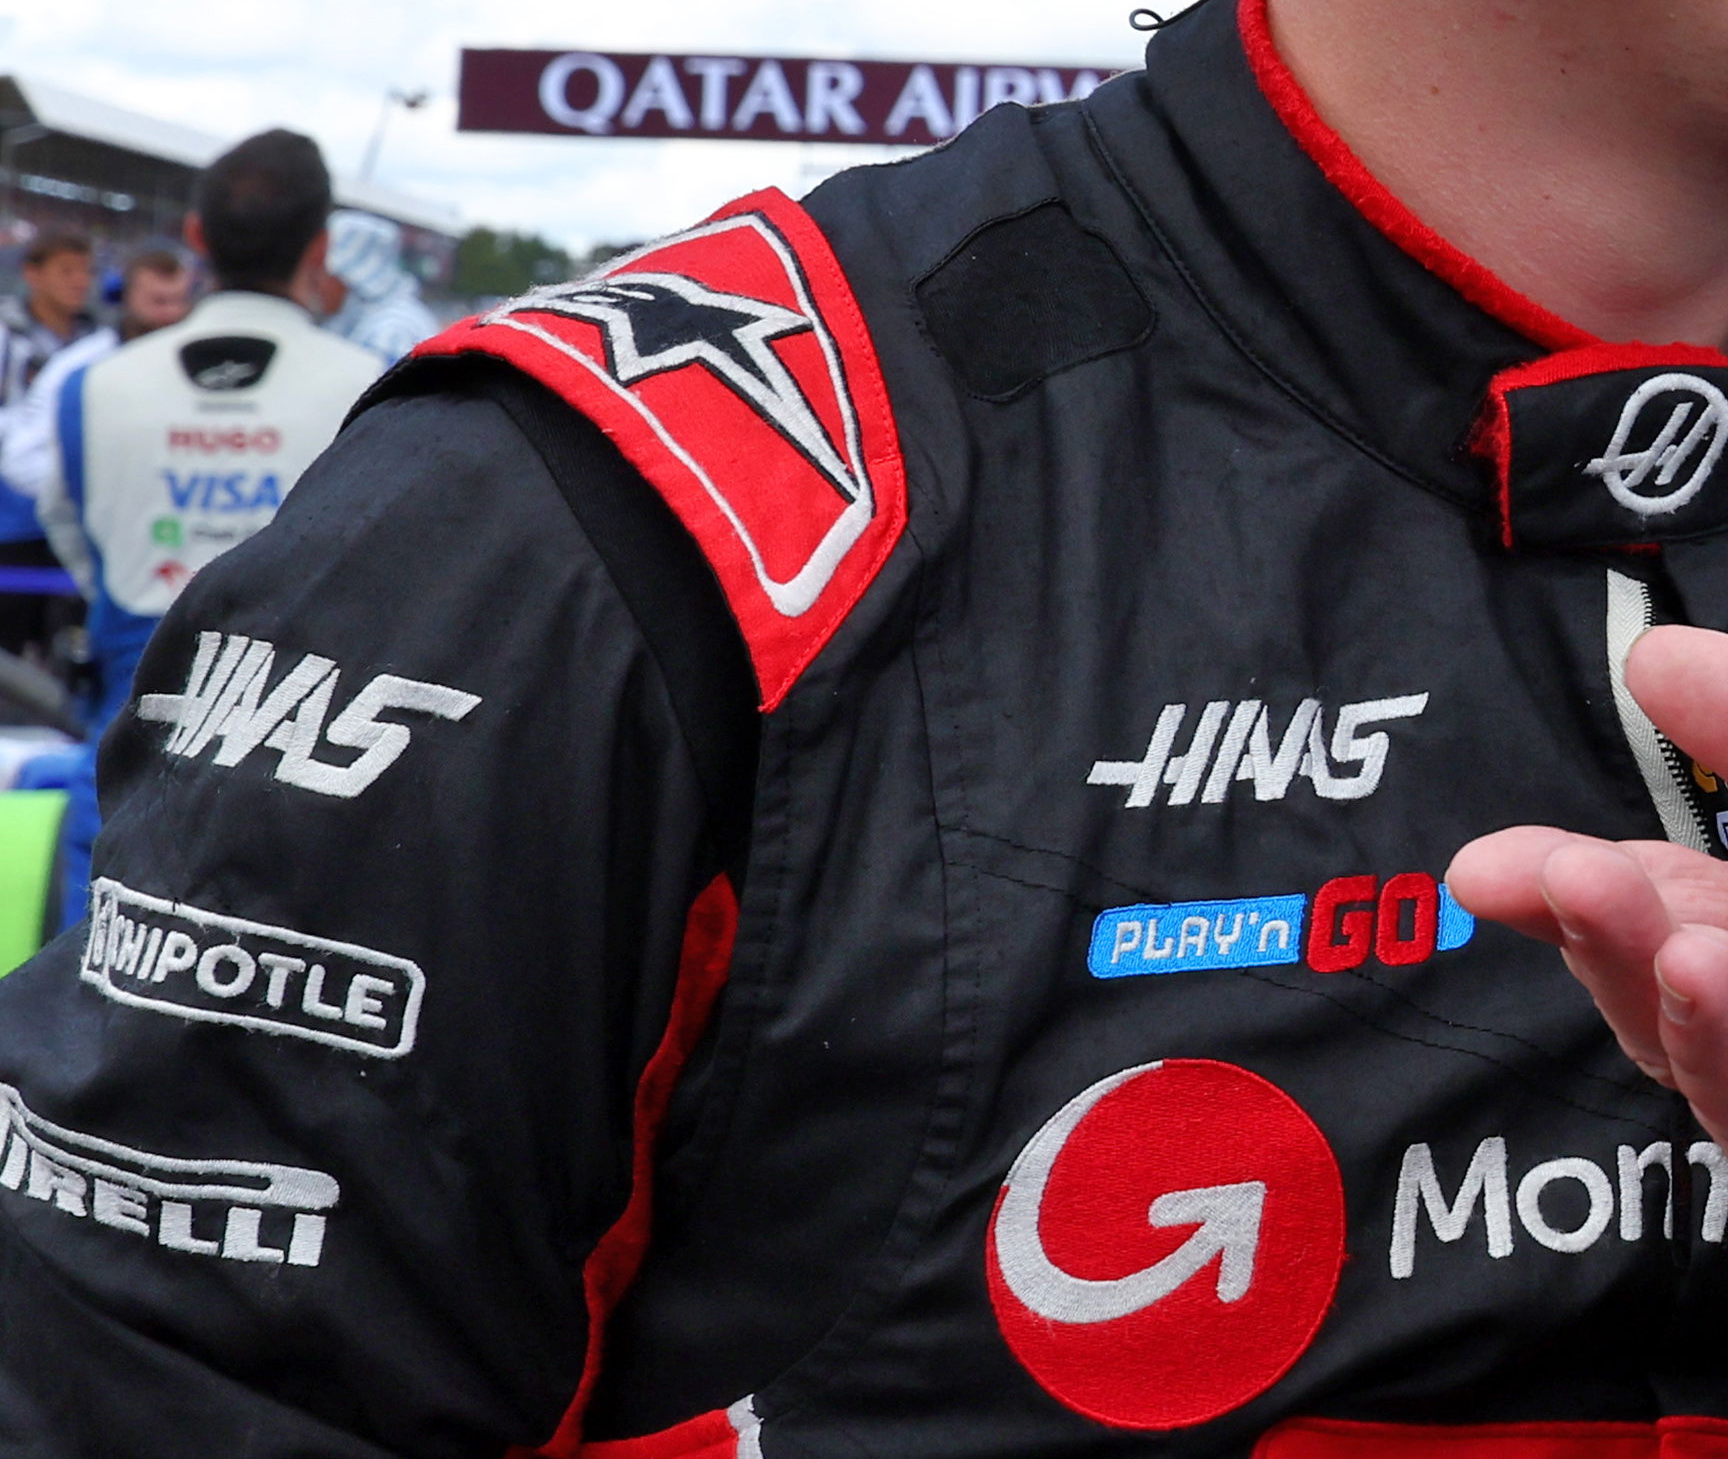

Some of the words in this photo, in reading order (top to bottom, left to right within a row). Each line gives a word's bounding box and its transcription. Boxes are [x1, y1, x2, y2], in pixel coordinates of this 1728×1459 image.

[538, 52, 870, 135] QATAR
[158, 467, 282, 511] VISA
[138, 631, 483, 798] HAAS
[1086, 691, 1430, 809] HAAS
[1110, 912, 1291, 964] PLAY'n
[1306, 872, 1438, 973] GO
